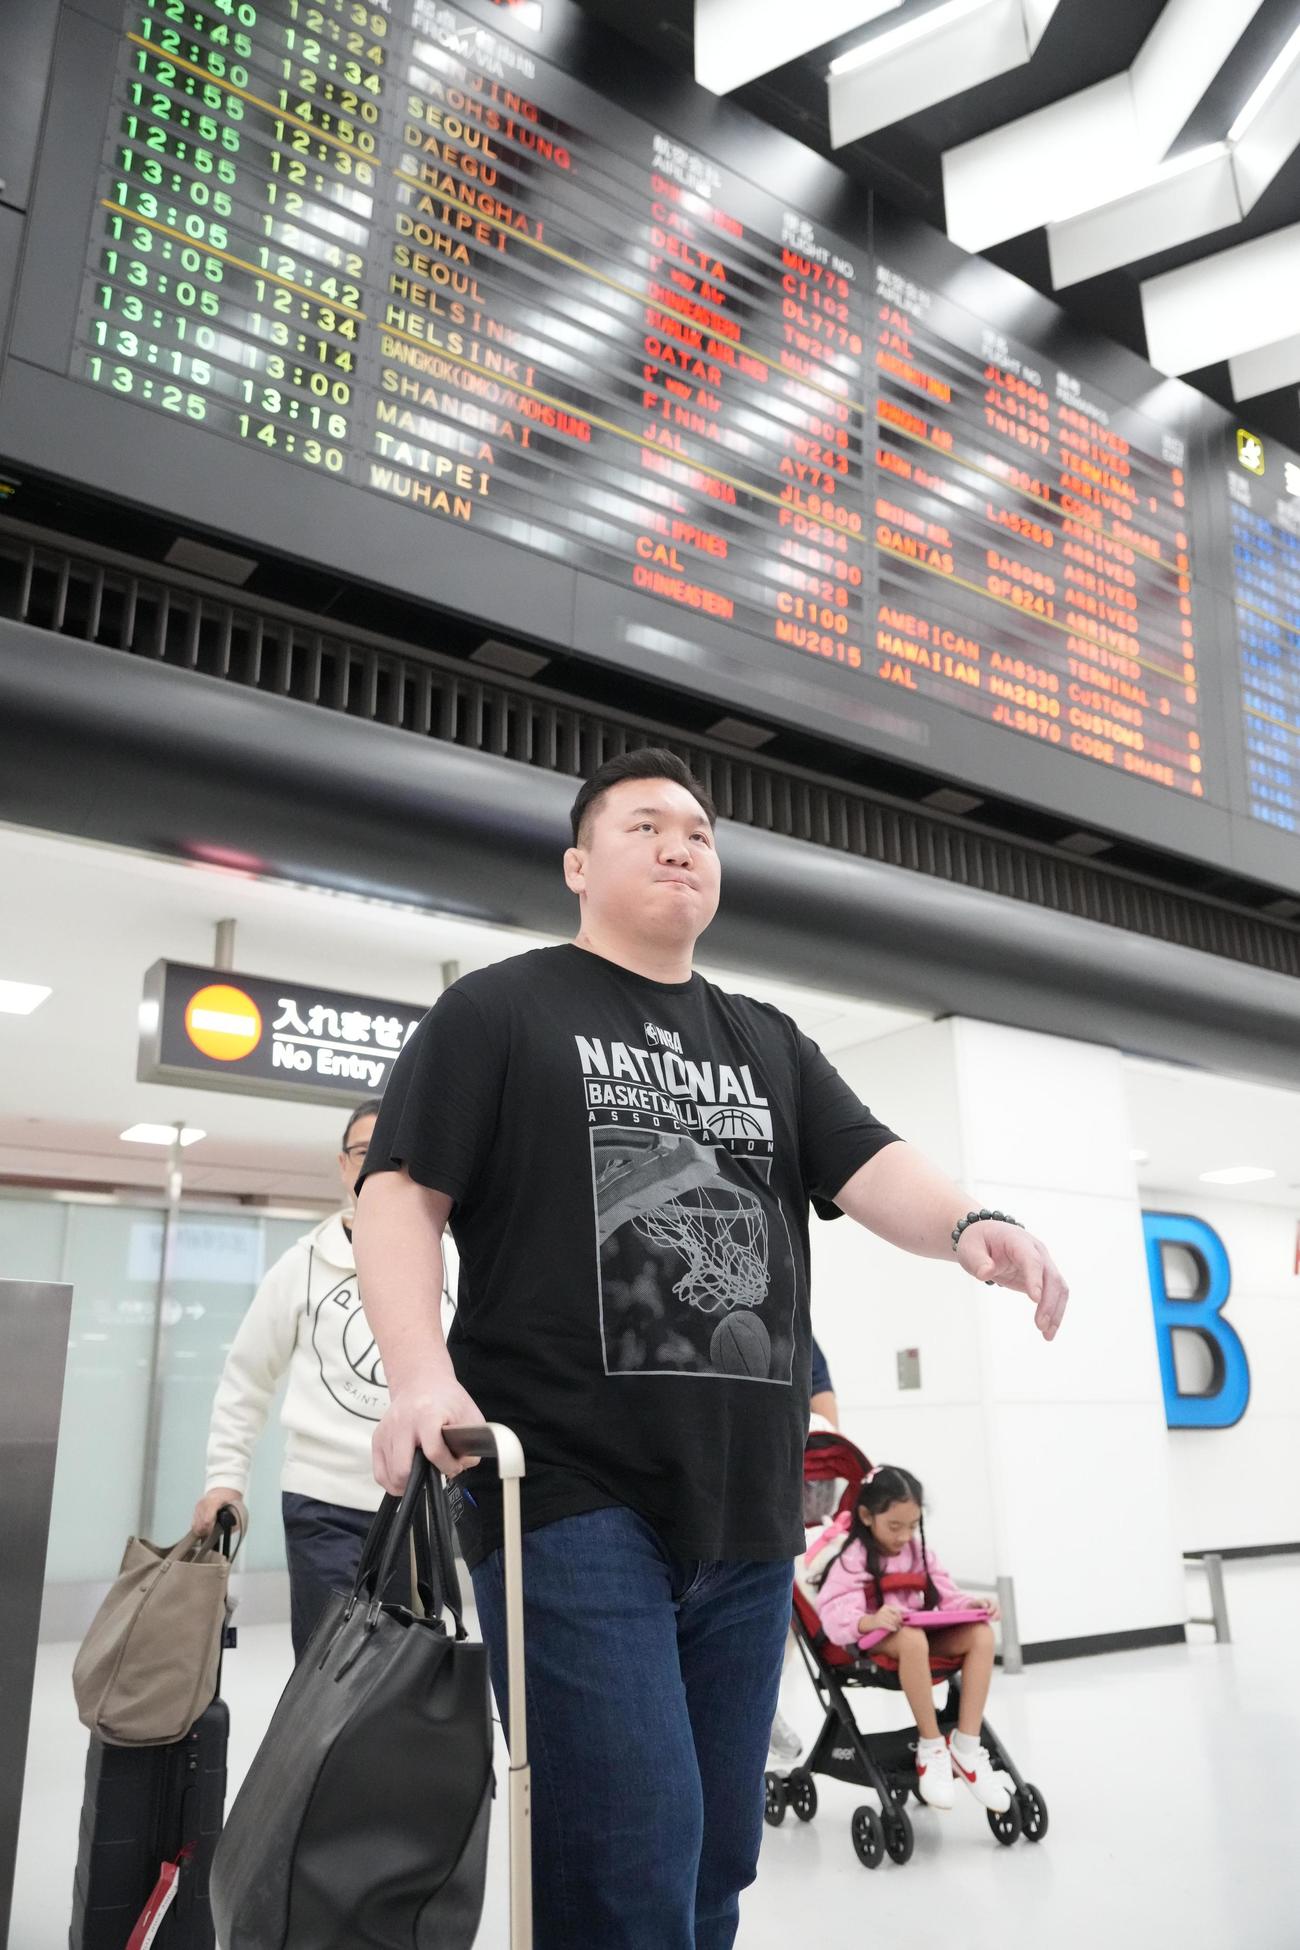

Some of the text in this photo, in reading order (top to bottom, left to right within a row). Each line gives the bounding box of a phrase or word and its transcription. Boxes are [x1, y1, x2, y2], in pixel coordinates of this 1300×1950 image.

[142, 17, 249, 88] 12:50
[284, 28, 381, 95] 12:34
[137, 50, 244, 121] 12:55
[281, 59, 378, 124] 12:20
[132, 83, 240, 152] 12:55
[277, 89, 375, 154] 14:50
[408, 95, 497, 160] SEOUL
[127, 115, 236, 184] 12:55
[405, 123, 497, 187] DAEGU
[122, 148, 232, 217] 13:05
[401, 153, 544, 242] SHANGHAI
[117, 182, 228, 250] 13:05
[396, 212, 470, 266] DOHA
[398, 183, 507, 253] TAIPEI
[112, 216, 224, 283] 13:05
[652, 225, 727, 282] DELTA
[782, 227, 831, 264] FLIGHT
[107, 251, 220, 316] 13:05
[259, 247, 360, 309] 12:42
[394, 245, 485, 304] SEOUL
[101, 286, 216, 350] 13:10
[255, 280, 357, 340] 12:34
[95, 321, 212, 386] 13:15
[251, 313, 353, 372] 13:14
[386, 304, 537, 388] HELSINKI
[644, 337, 722, 387] QATAR
[90, 357, 206, 420] 13:25
[247, 345, 351, 405] 13:00
[243, 380, 347, 438] 13:16
[1058, 405, 1129, 455] ARRIVED
[239, 415, 343, 472] 14:30
[375, 431, 491, 496] TAIPEI
[643, 422, 688, 457] JAL
[1059, 428, 1130, 477] ARRIVED
[370, 465, 473, 521] WUHAN
[780, 456, 835, 495] AY73
[635, 536, 685, 572] CAL
[876, 524, 954, 575] QANTAS
[1062, 519, 1135, 566] ARRIVED
[1063, 542, 1135, 587] ARRIVED
[776, 591, 848, 635] CI100
[1064, 564, 1137, 610] ARRIVED
[1065, 588, 1138, 633] ARRIVED
[775, 618, 862, 668] MU2615
[876, 629, 981, 688] HAWAIIAN
[877, 605, 980, 661] AMERICAN
[1066, 611, 1140, 657] ARRIVED
[1067, 635, 1141, 680] ARRIVED
[879, 660, 918, 690] JAL
[1067, 656, 1150, 708] TERMINAL
[1068, 683, 1143, 727] CUSTOMS
[1069, 707, 1145, 751] CUSTOMS
[272, 1042, 385, 1088] No Entry
[656, 1026, 684, 1055] NBA
[574, 1034, 769, 1107] NATIONAL
[588, 1083, 698, 1125] BASKETBALL
[588, 1111, 773, 1153] ASSOCAION
[1141, 1208, 1251, 1431] B
